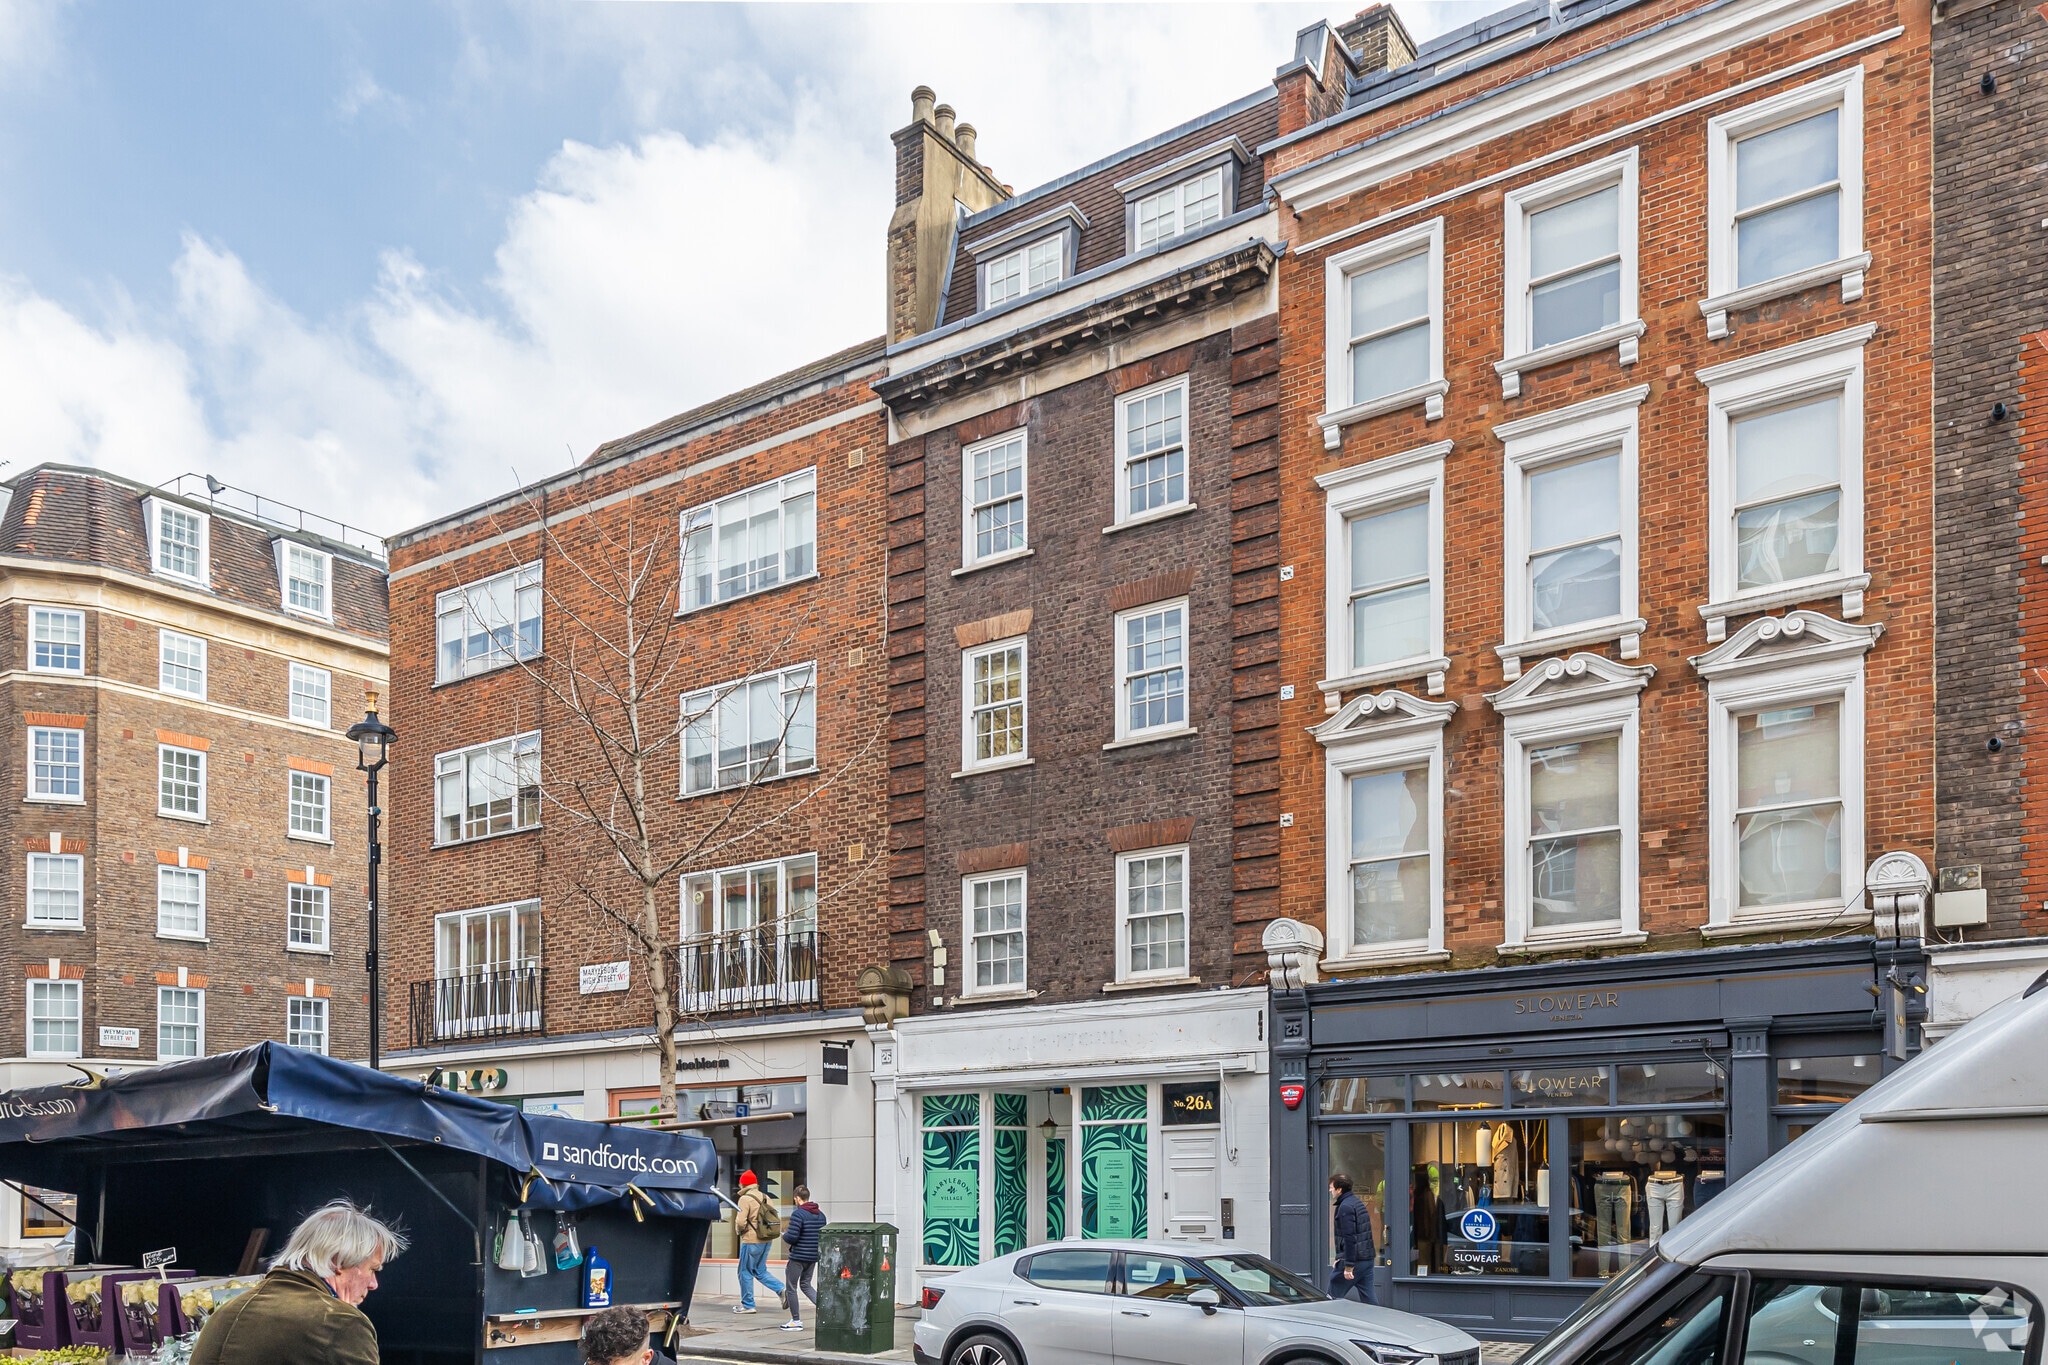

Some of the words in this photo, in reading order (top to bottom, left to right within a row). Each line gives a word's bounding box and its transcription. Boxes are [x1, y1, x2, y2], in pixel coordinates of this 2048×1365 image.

[597, 974, 616, 983] STREET
[617, 973, 626, 981] W1
[1515, 992, 1619, 1014] SLOWEAR
[1285, 1024, 1300, 1036] 25
[881, 1051, 892, 1063] 26
[1520, 1076, 1601, 1094] SLOWEAR
[1186, 1095, 1213, 1110] 26A
[563, 1143, 699, 1174] sandfords.com
[931, 1177, 973, 1197] MARYLEBONE
[1474, 1214, 1483, 1223] N
[1474, 1228, 1482, 1236] S
[1454, 1253, 1500, 1263] SLOWEAR
